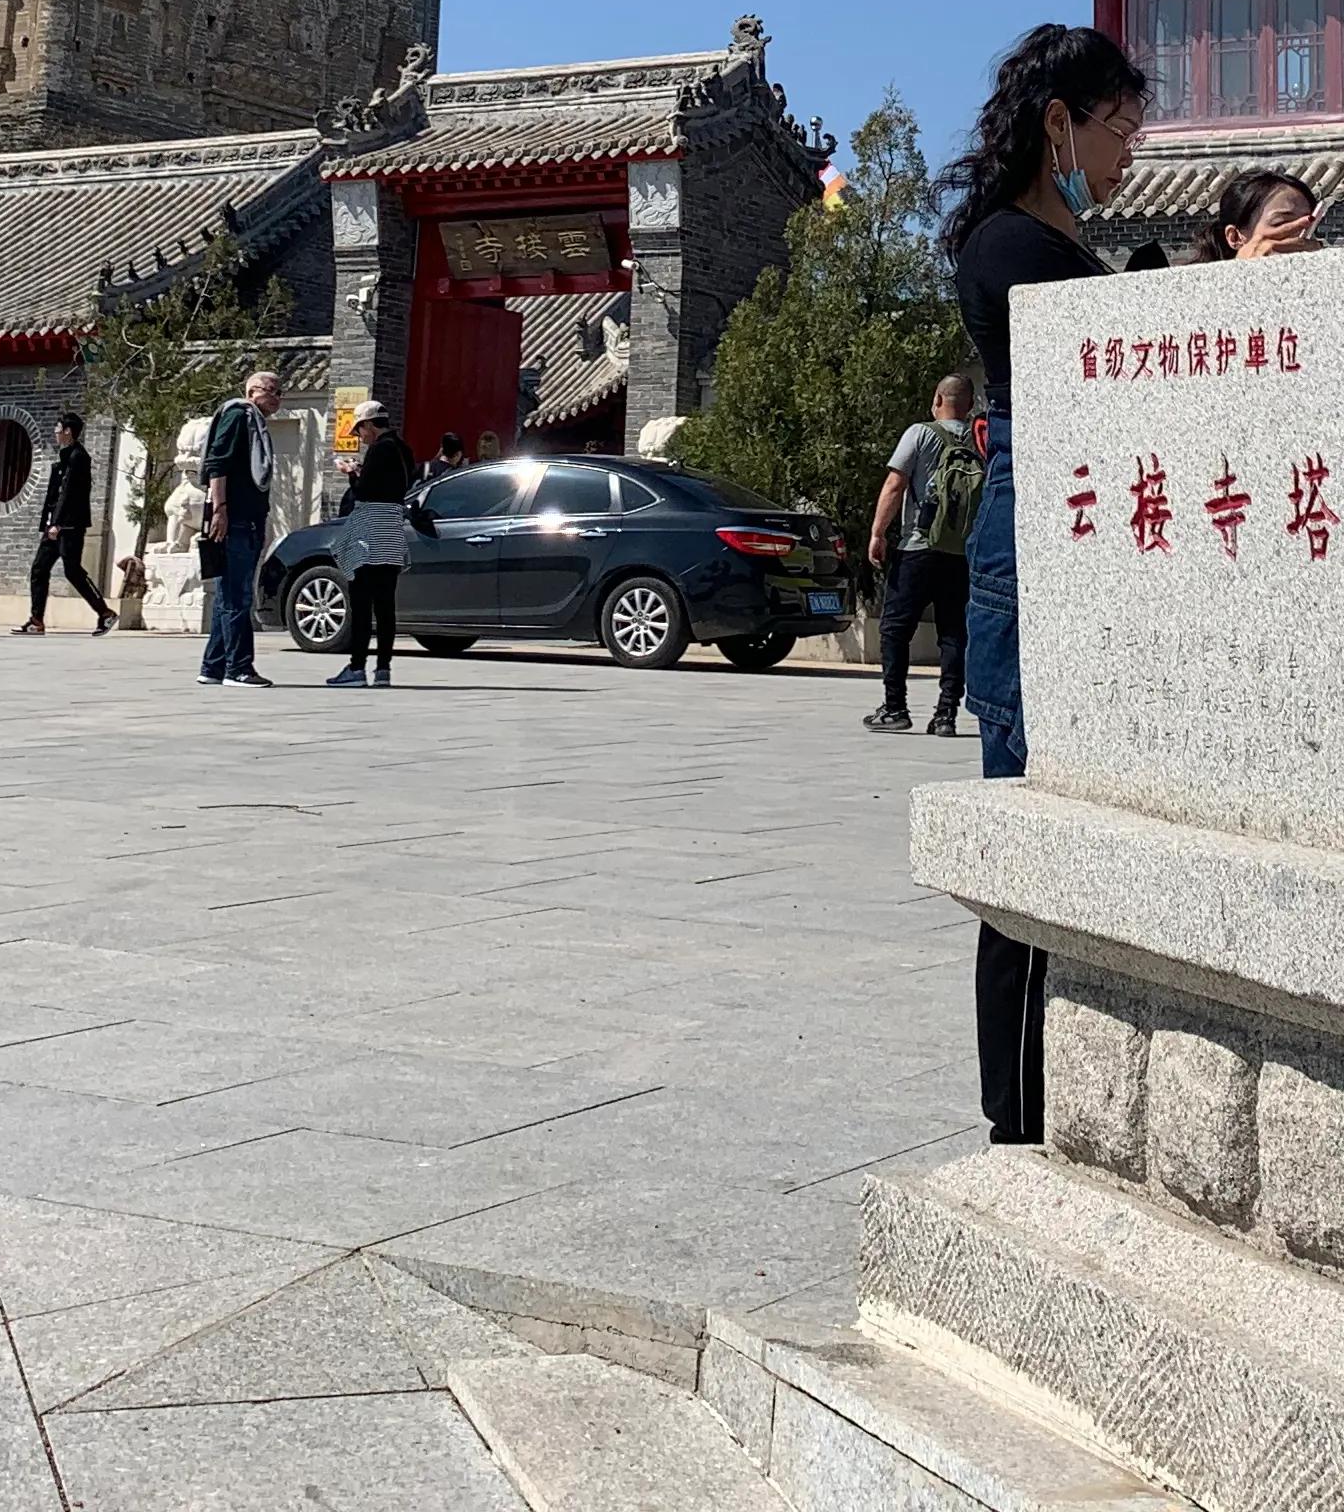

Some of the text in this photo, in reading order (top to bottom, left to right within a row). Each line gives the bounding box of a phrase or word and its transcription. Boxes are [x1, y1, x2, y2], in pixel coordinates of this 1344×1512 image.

[1079, 326, 1303, 381] 省级文物保护单位
[1066, 452, 1341, 561] 云接寺塔
